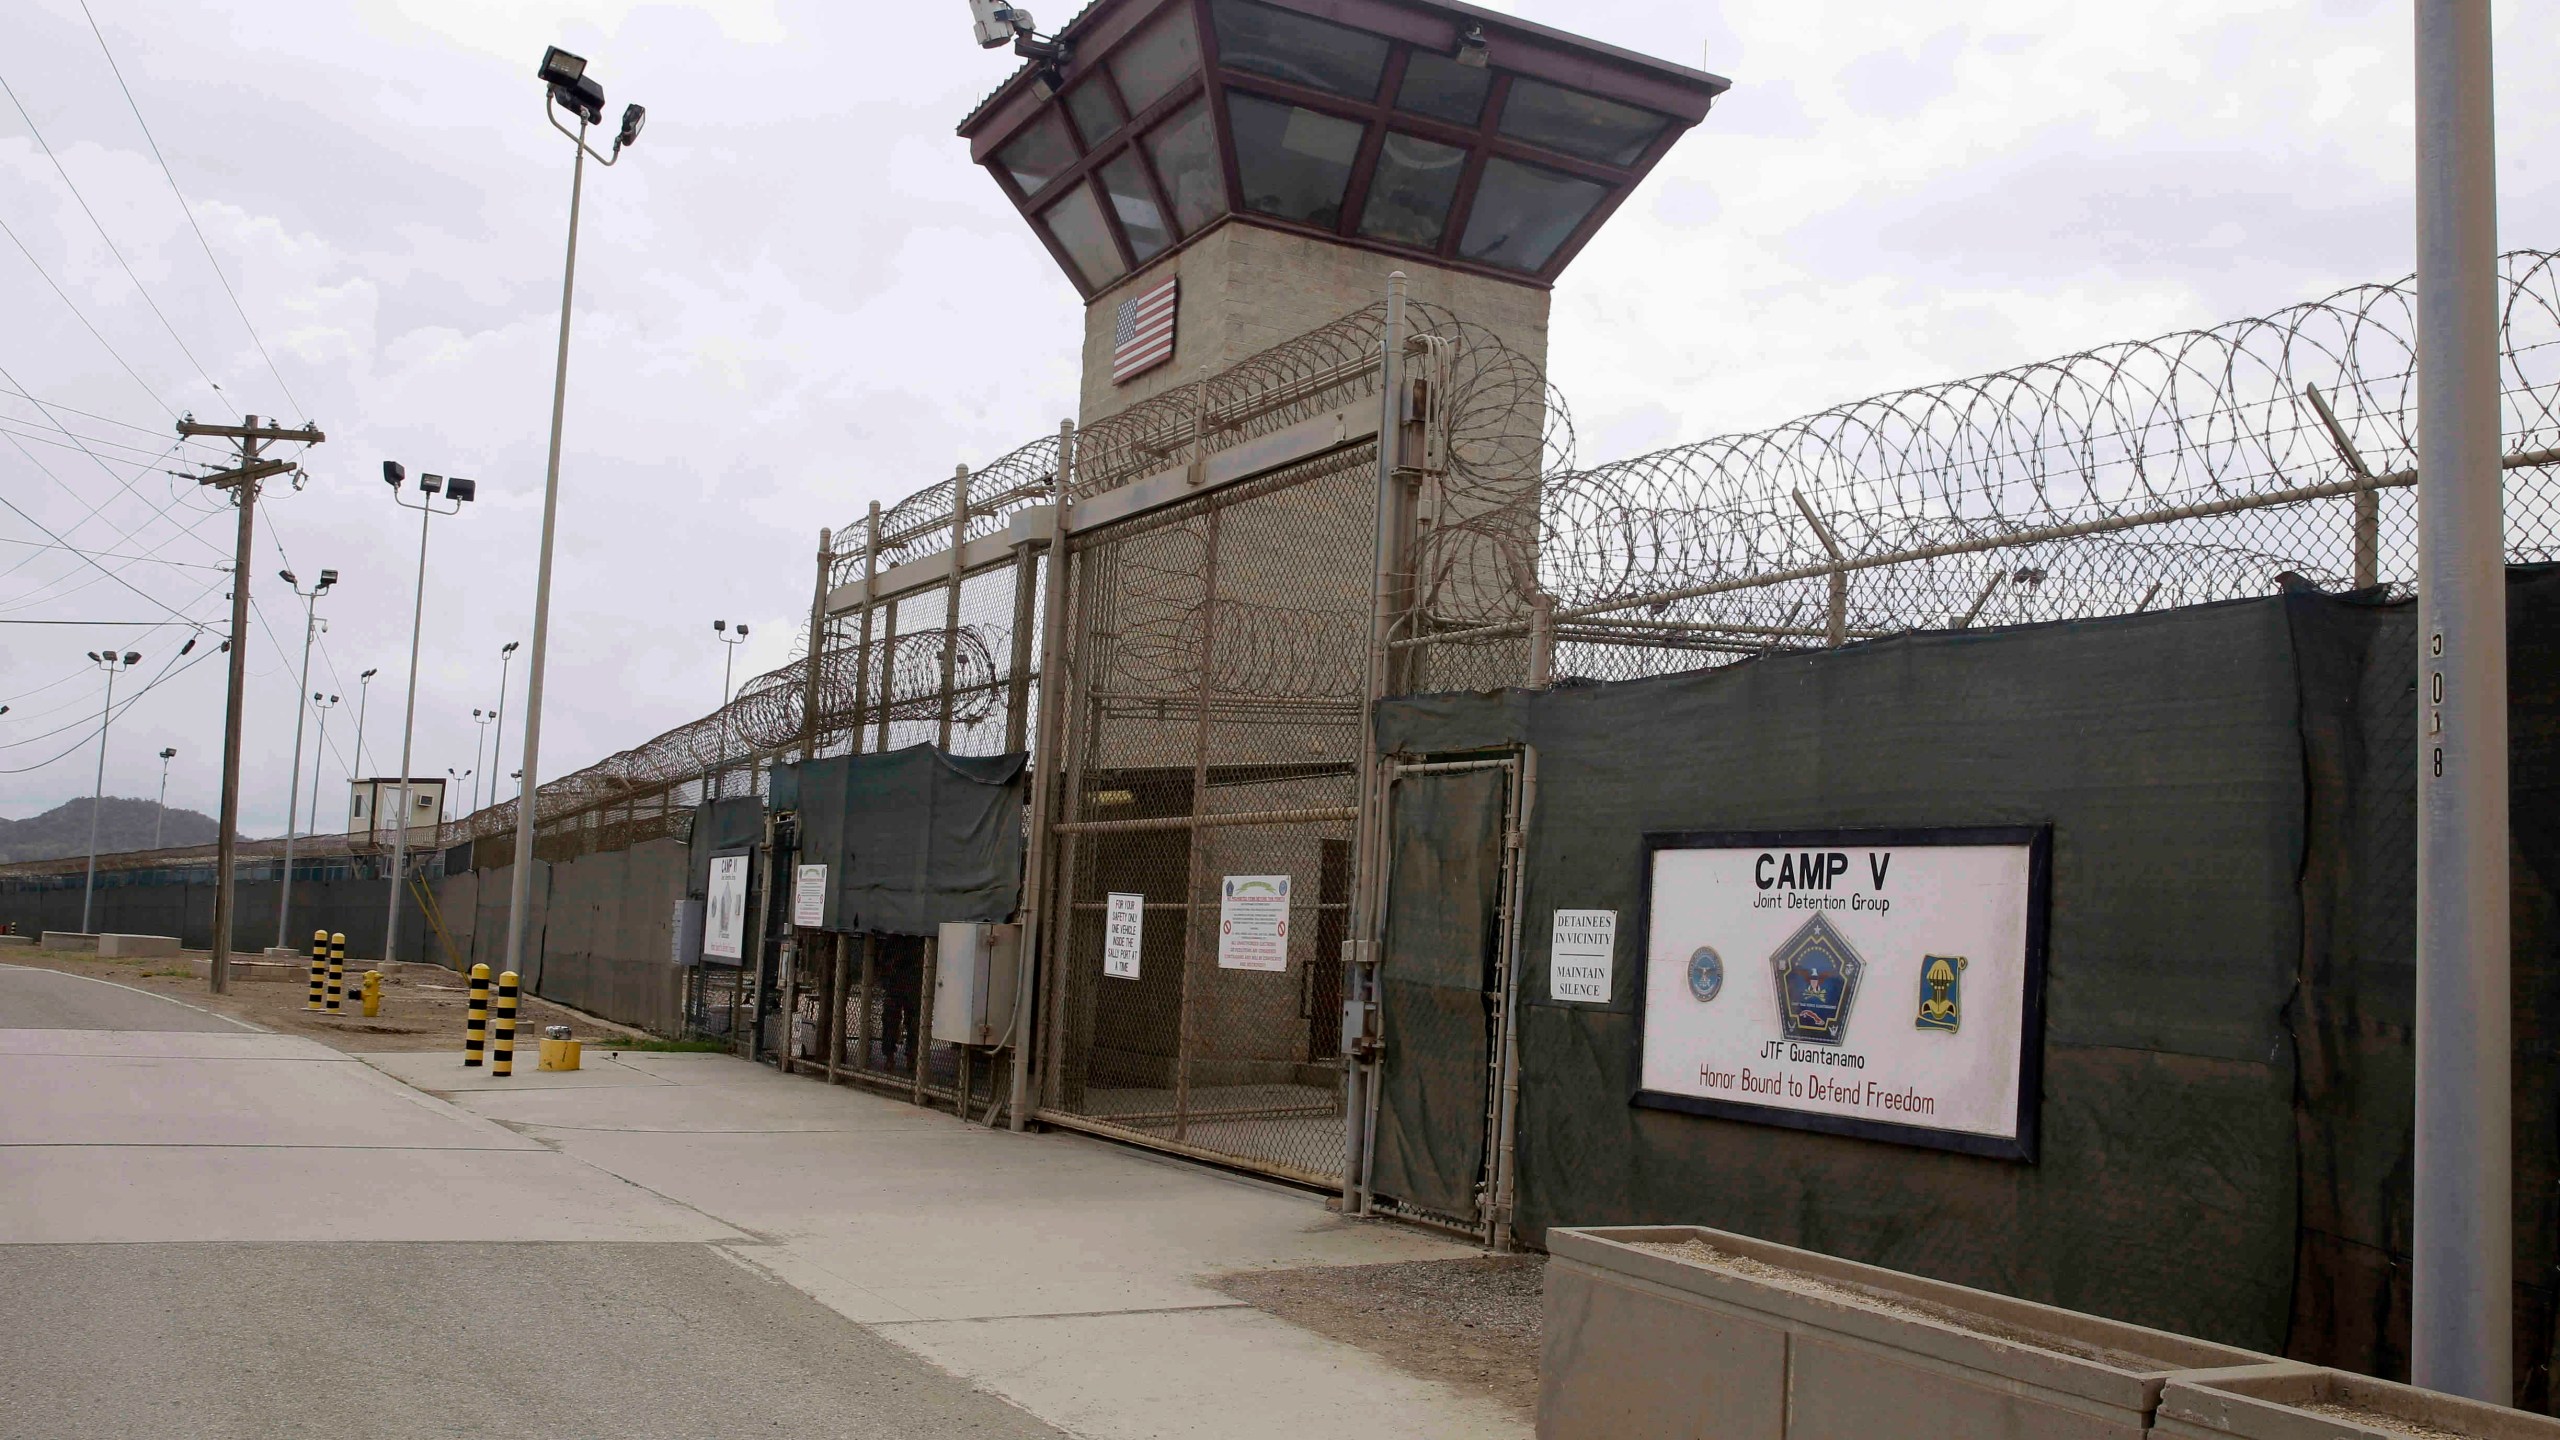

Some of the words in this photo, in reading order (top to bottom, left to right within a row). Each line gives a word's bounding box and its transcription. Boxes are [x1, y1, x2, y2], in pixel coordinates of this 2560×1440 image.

[721, 858, 733, 873] CAMP
[1755, 852, 1848, 890] CAMP
[1869, 852, 1891, 891] V
[1115, 899, 1123, 910] FOR
[1124, 900, 1135, 910] YOUR
[1753, 891, 1782, 909] Joint
[1787, 892, 1846, 910] Detention
[1851, 892, 1890, 917] Group
[1112, 911, 1127, 922] SAFETY
[1128, 912, 1137, 923] ONLY
[1557, 915, 1612, 928] DETAINEES
[1111, 923, 1119, 934] ONE
[1120, 924, 1137, 936] VEHICLE
[1126, 937, 1134, 948] THE
[1555, 932, 1565, 944] IN
[1567, 932, 1612, 945] VICINITY
[1107, 947, 1119, 959] SALLY
[1120, 949, 1131, 960] PORT
[1131, 950, 1138, 961] AT
[1114, 960, 1118, 971] A
[1119, 961, 1129, 973] TIME
[1556, 966, 1605, 979] MAINTAIN
[1559, 982, 1600, 997] SILENCE
[1760, 1040, 1784, 1060] JTF
[1789, 1043, 1865, 1069] Guantanamo
[1699, 1063, 1736, 1090] Honor
[1741, 1067, 1782, 1096] Bound
[1788, 1074, 1803, 1098] to
[1808, 1074, 1861, 1106] Defend
[1866, 1081, 1935, 1115] Freedom
